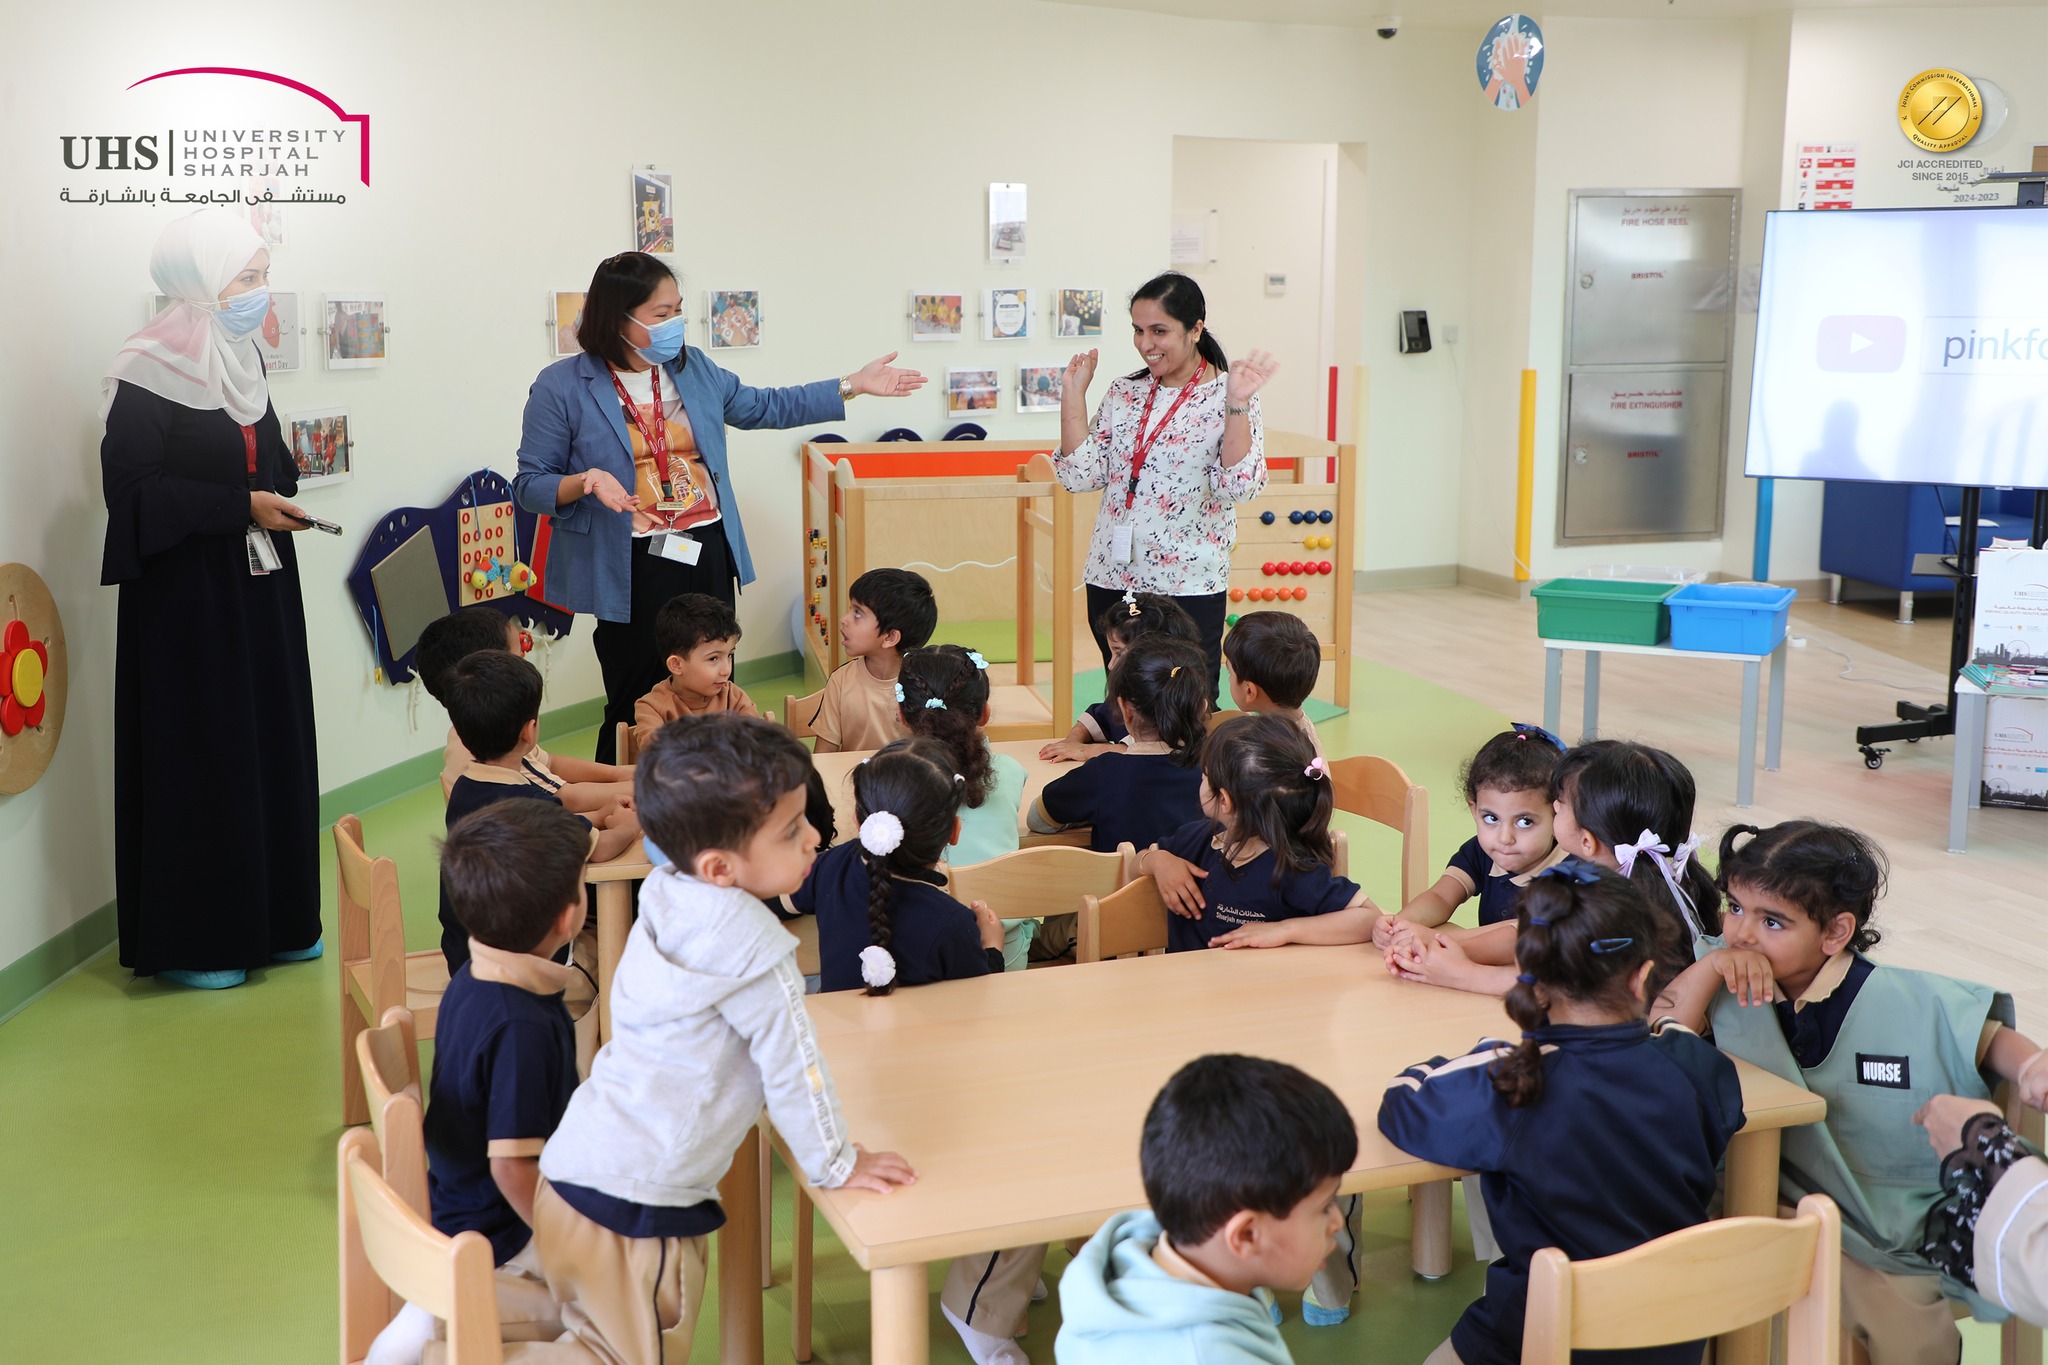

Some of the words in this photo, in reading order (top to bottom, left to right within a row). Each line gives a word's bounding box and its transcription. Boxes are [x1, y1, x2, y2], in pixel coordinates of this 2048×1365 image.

[1953, 192, 1999, 203] 2024-2023
[1621, 218, 1640, 226] FIRE
[1642, 217, 1665, 226] HOSE
[1667, 217, 1688, 226] REEL
[1631, 272, 1664, 280] BRISTOL
[1610, 401, 1627, 409] FIRE
[1629, 401, 1683, 409] EXTINGUISHER
[1215, 911, 1236, 924] Sharjah
[1862, 1061, 1901, 1083] NURSE
[813, 1089, 835, 1141] AWESOME
